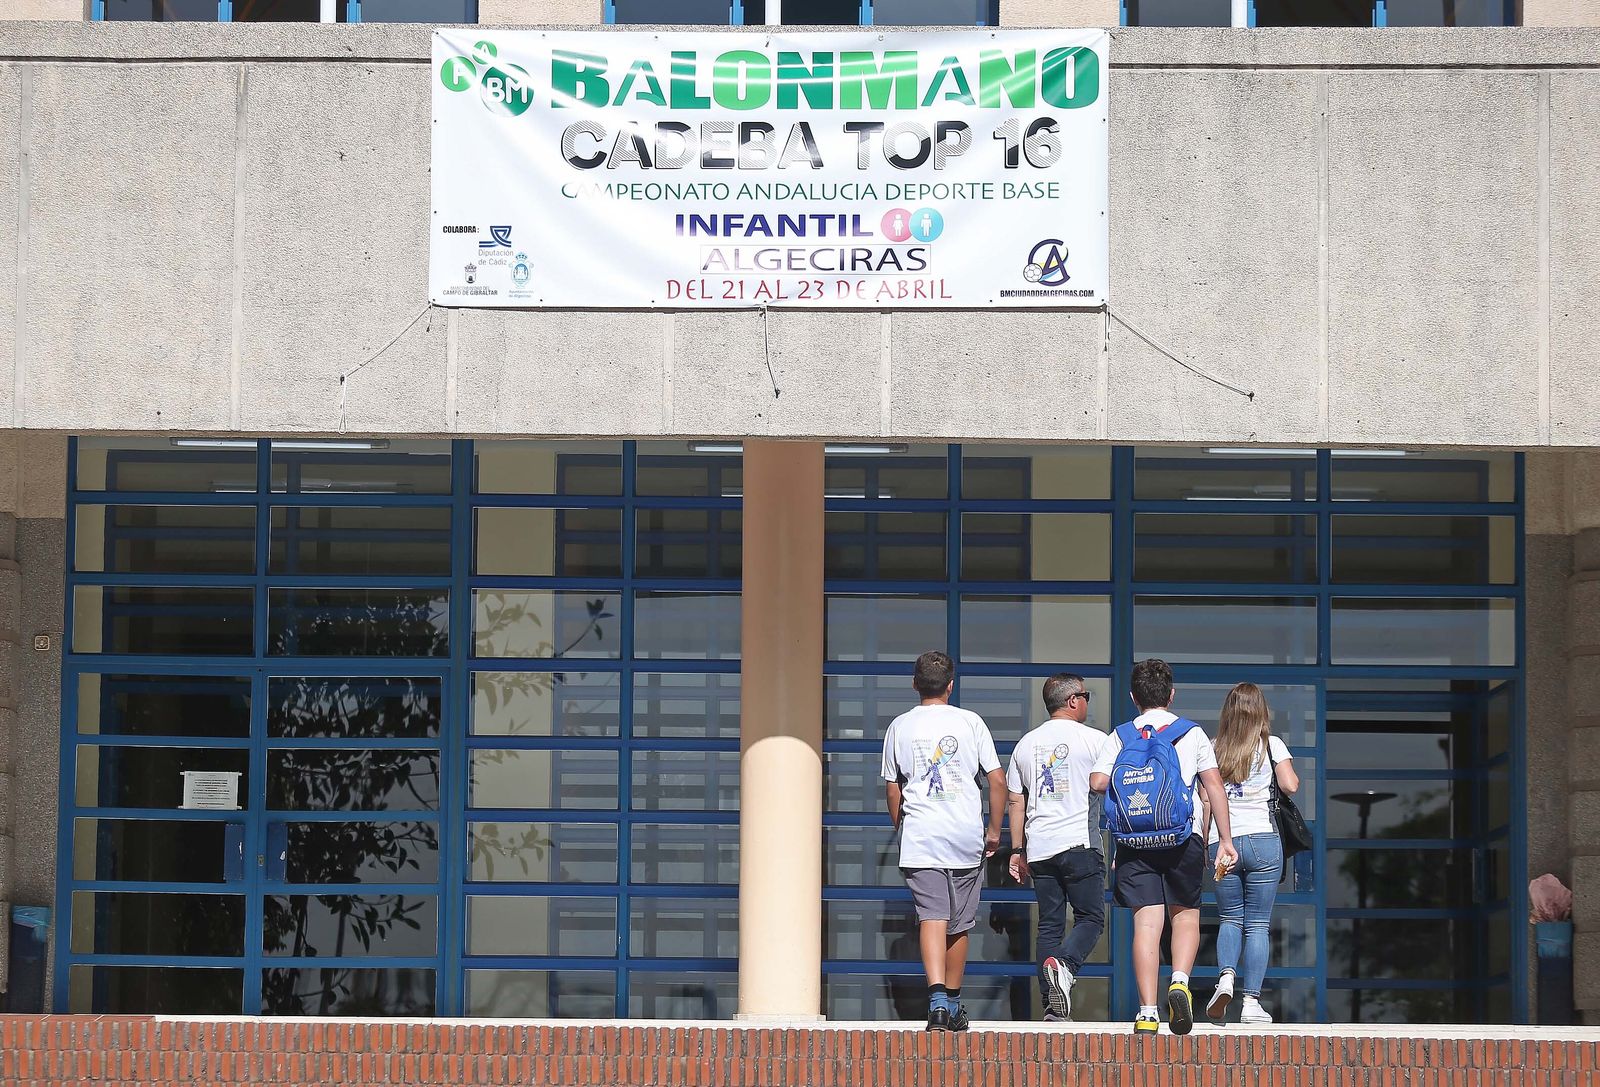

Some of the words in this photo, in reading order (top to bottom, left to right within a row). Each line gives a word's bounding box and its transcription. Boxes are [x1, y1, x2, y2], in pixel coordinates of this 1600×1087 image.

[551, 46, 1100, 110] BALONMANO
[486, 76, 529, 104] BM
[560, 119, 824, 170] CADEBA
[843, 120, 973, 170] TOP
[993, 116, 1063, 169] 16
[561, 182, 730, 200] CAMPEONATO
[736, 182, 878, 200] ANDALUCIA
[885, 182, 994, 200] DEPORTE
[1003, 181, 1060, 200] BASE
[442, 225, 480, 234] COLABORA:
[675, 213, 874, 237] INFANTIL
[478, 249, 514, 257] Diputación
[702, 247, 928, 272] ALGECIRAS
[666, 278, 714, 300] DEL
[722, 279, 744, 300] 21
[753, 278, 789, 300] AL
[797, 279, 825, 300] 23
[836, 279, 867, 300] DE
[876, 278, 953, 300] ABRIL
[1128, 807, 1153, 816] luanvi
